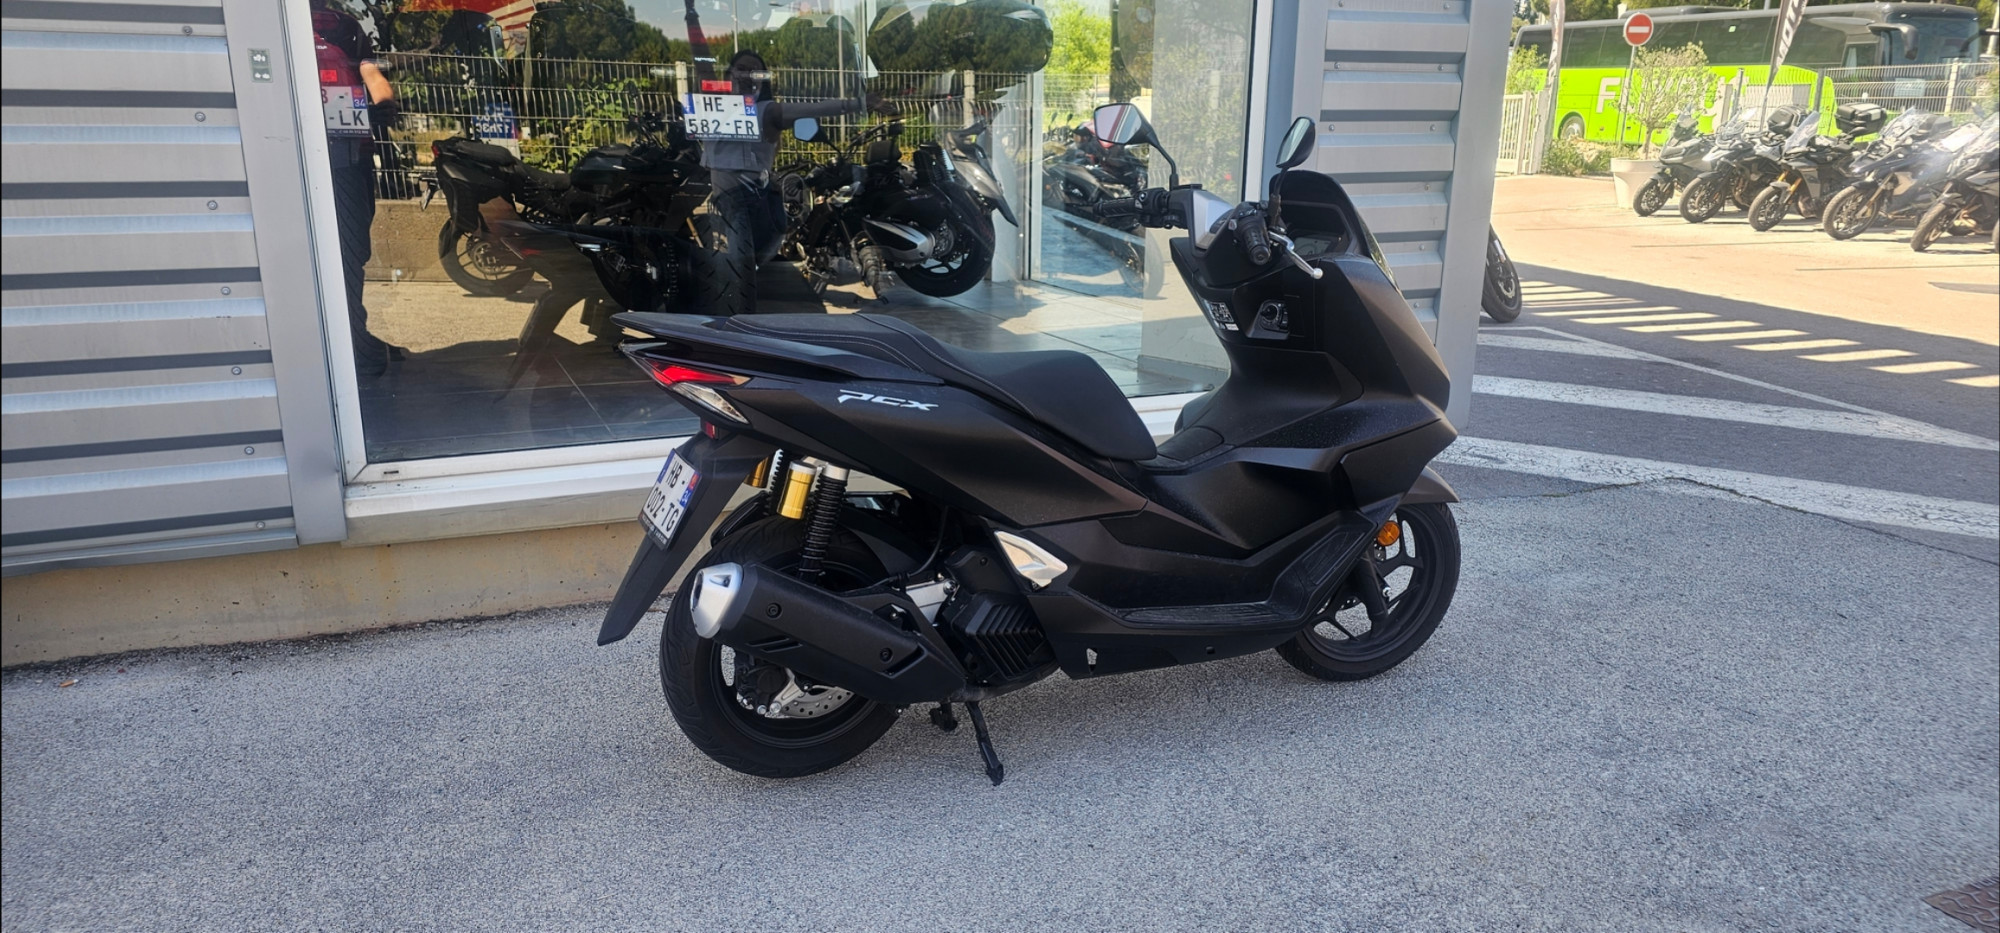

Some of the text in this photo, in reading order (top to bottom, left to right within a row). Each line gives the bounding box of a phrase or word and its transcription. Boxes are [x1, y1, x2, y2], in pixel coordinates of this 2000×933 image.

[354, 98, 365, 107] 34
[703, 96, 724, 112] HE
[745, 106, 756, 115] 34
[837, 389, 939, 411] PCX
[666, 460, 682, 488] HB
[679, 488, 692, 504] 34
